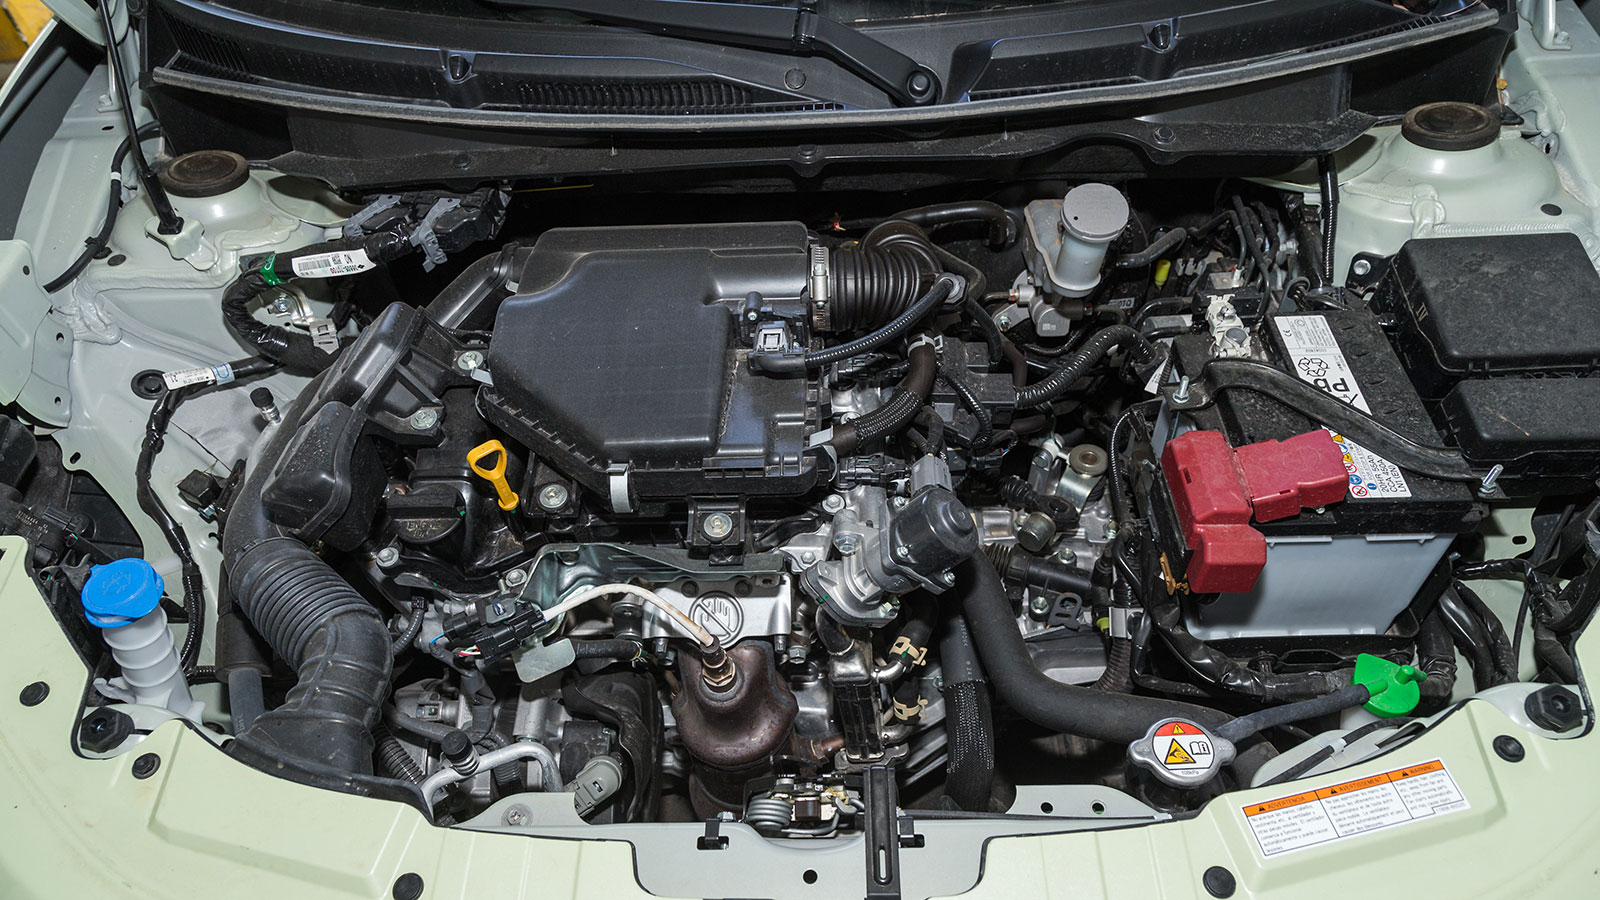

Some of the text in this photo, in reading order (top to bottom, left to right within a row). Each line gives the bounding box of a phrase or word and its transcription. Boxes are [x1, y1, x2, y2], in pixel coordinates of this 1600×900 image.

[1313, 377, 1350, 392] Pb
[1367, 455, 1389, 492] 20HR 55Ah
[1377, 459, 1397, 492] CCA 450A
[1388, 465, 1406, 492] LN1 (EN)
[1409, 764, 1434, 773] WARNING
[1338, 777, 1382, 791] AVERTISSEMENT
[1267, 796, 1305, 809] ADVERTENCIA
